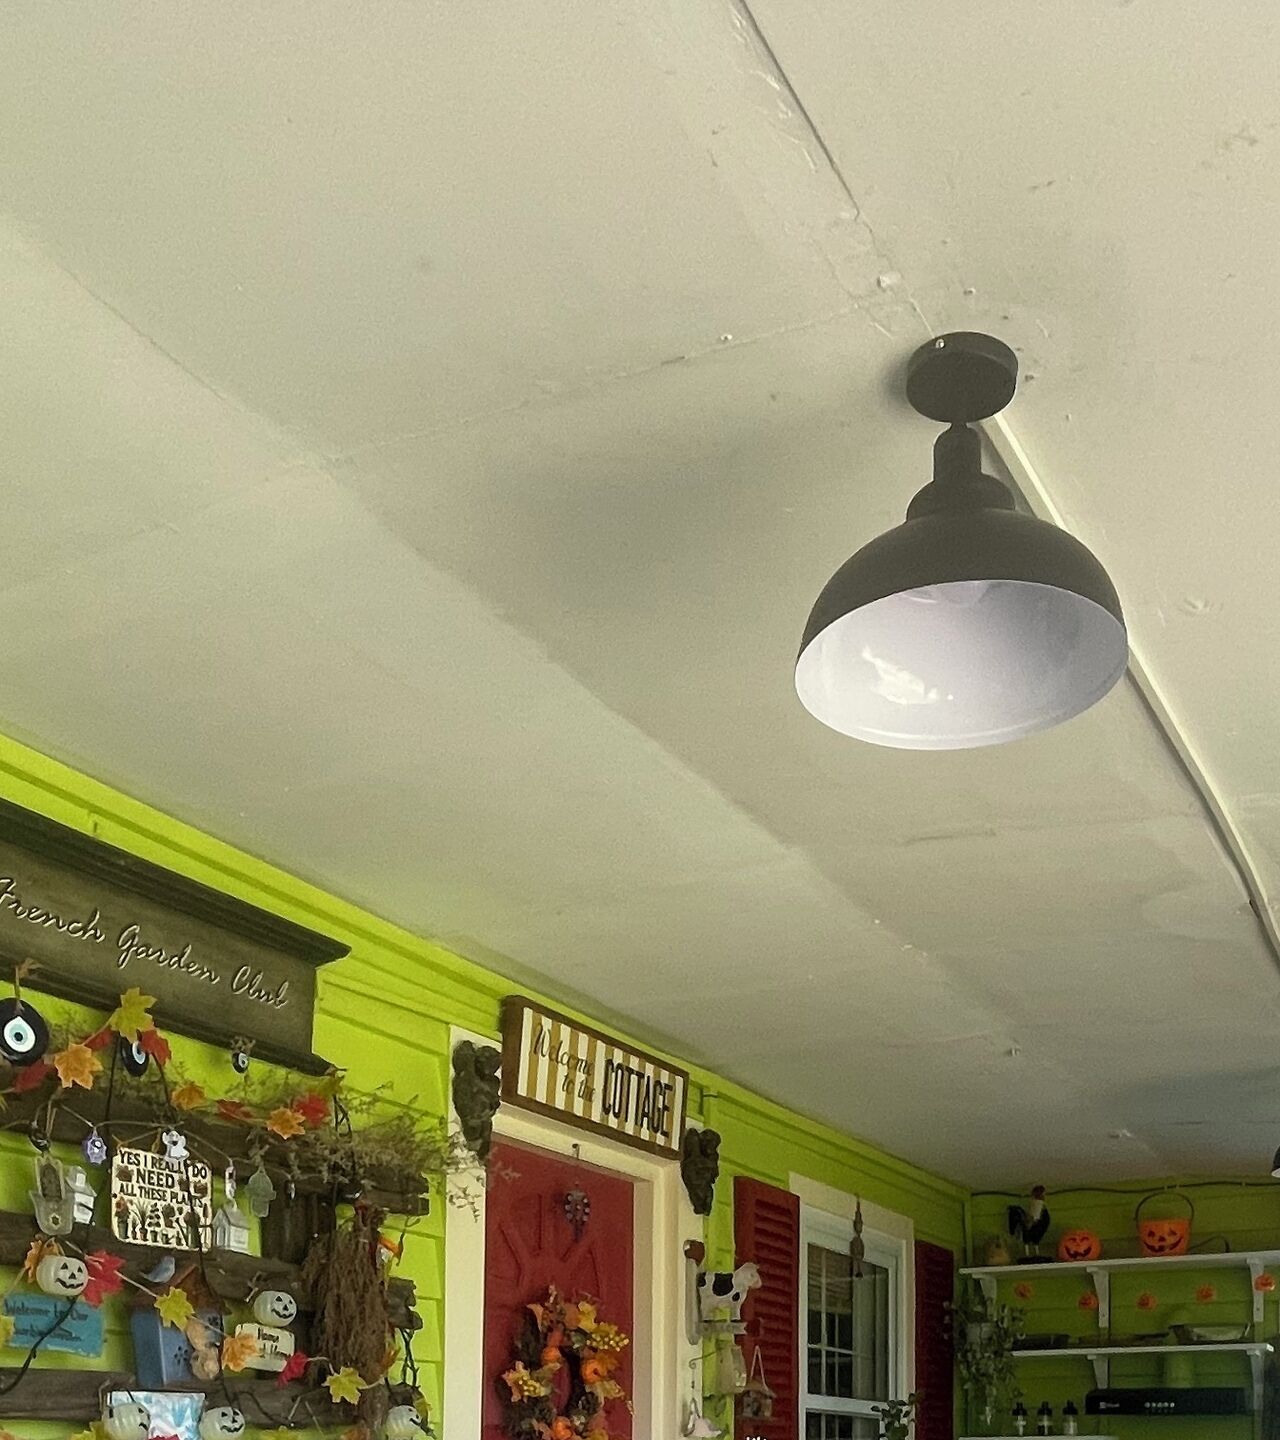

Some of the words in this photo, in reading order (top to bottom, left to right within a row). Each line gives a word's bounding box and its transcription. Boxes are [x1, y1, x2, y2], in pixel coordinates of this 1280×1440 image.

[118, 924, 220, 985] Garden
[231, 965, 290, 1009] Club
[534, 1024, 595, 1077] Welcome
[562, 1070, 575, 1094] to
[578, 1074, 596, 1102] the
[602, 1058, 673, 1138] COTTAGE
[119, 1149, 141, 1167] YES
[144, 1154, 148, 1168] I
[151, 1156, 191, 1176] REALL
[192, 1164, 208, 1180] DO
[136, 1168, 175, 1189] NEED
[120, 1182, 137, 1197] ALL
[138, 1186, 167, 1202] THESE
